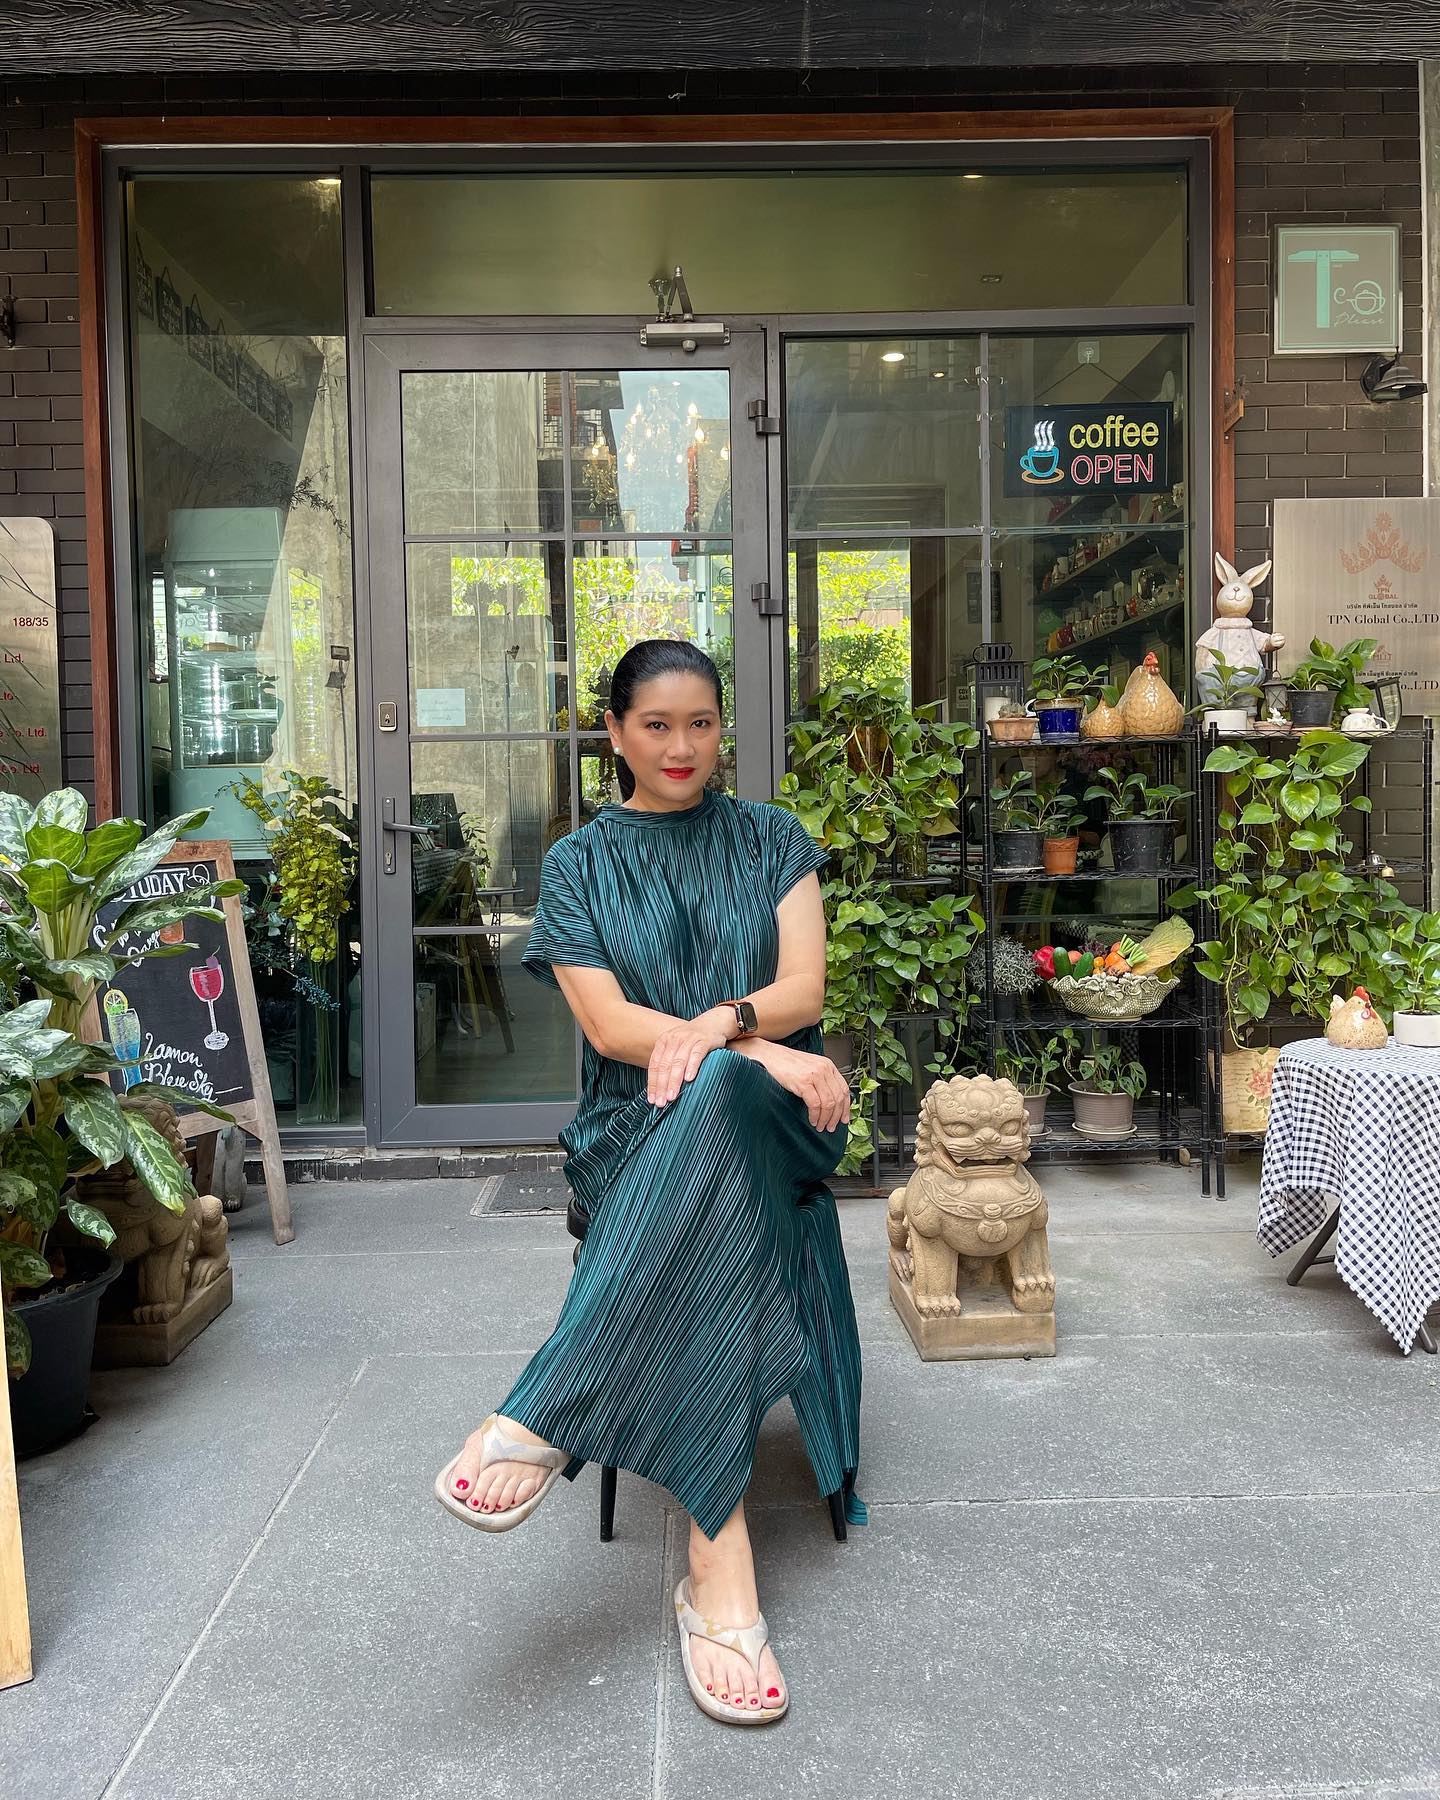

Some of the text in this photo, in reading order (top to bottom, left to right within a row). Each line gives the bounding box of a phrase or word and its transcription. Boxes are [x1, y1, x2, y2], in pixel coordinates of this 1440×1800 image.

[1069, 414, 1160, 449] coffee
[1070, 453, 1154, 486] OPEN
[12, 617, 49, 627] 188/35
[1327, 614, 1351, 624] TPN
[1354, 613, 1390, 624] Global
[1399, 680, 1439, 690] o.,LTD
[28, 727, 47, 738] Ltd.
